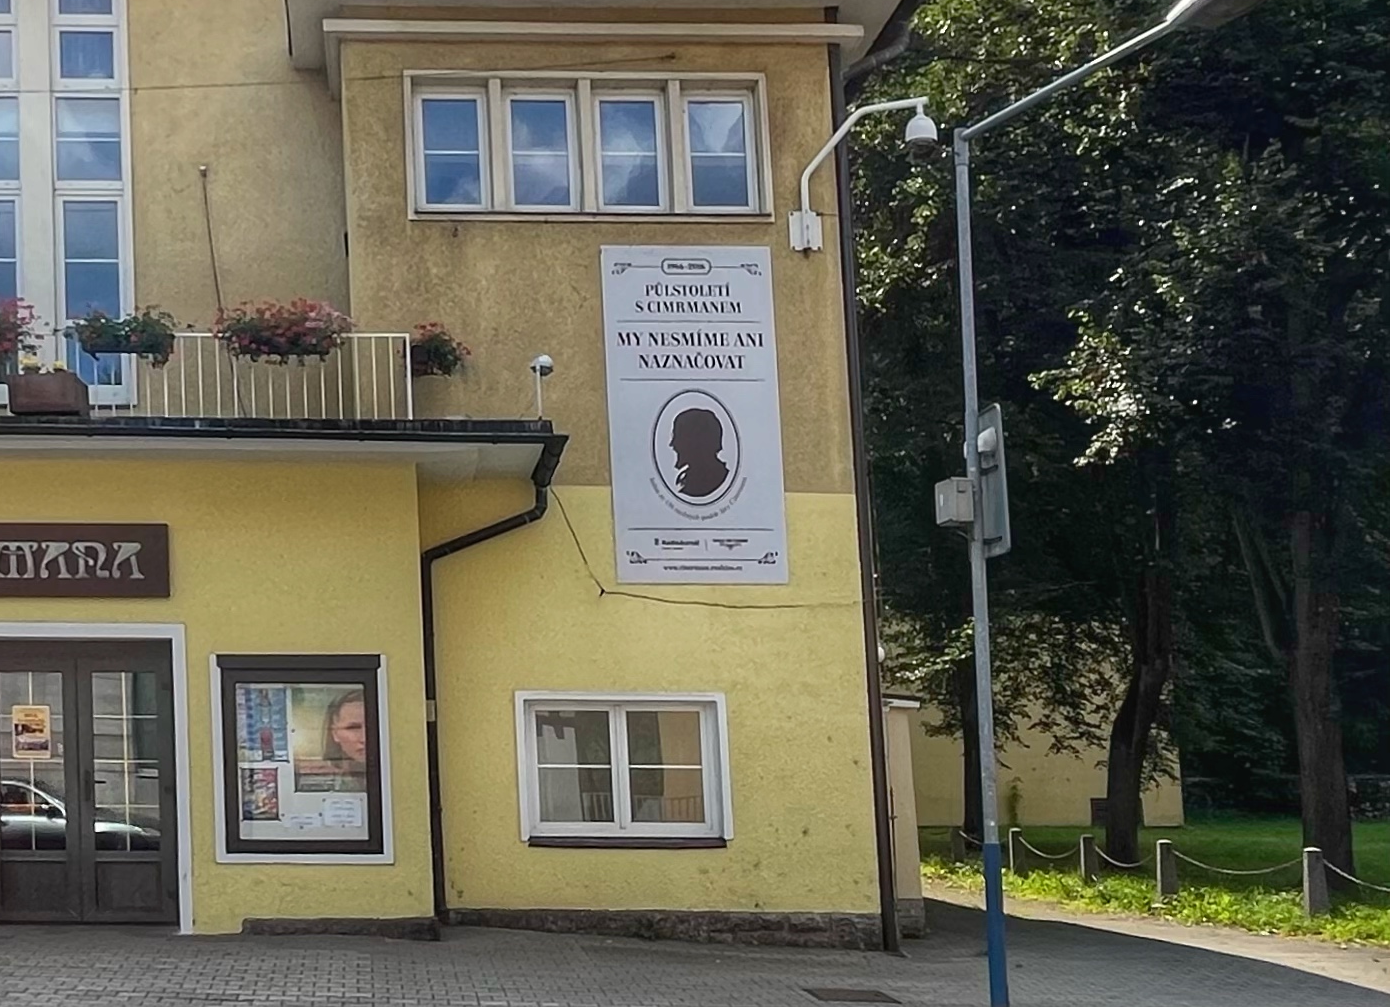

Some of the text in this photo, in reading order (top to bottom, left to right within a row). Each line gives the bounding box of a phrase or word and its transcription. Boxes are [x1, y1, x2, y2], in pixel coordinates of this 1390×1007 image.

[635, 300, 742, 314] S CIMRMANEM
[617, 328, 765, 348] MY NESMÍME ANI
[638, 351, 746, 370] NAZNAČOVAT
